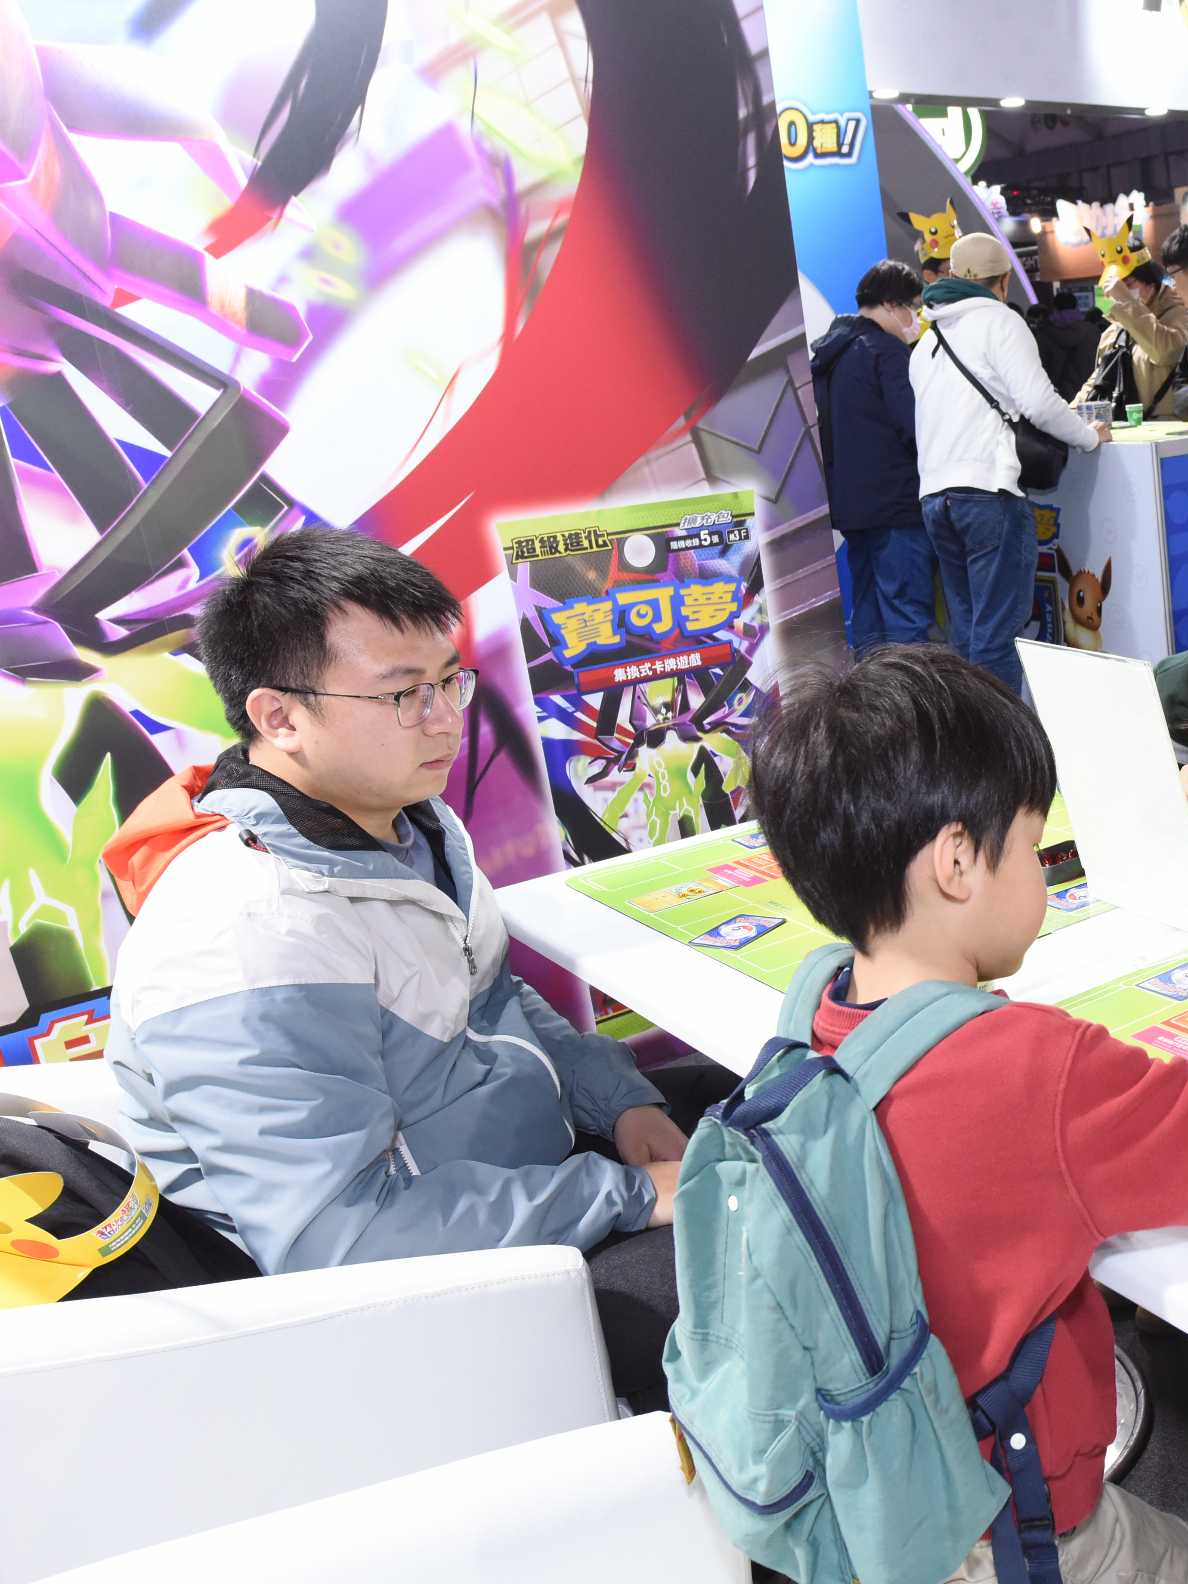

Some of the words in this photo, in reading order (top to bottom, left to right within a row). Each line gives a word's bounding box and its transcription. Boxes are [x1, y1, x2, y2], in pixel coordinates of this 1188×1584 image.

[513, 529, 611, 562] 超級進化
[550, 581, 739, 658] 寶可夢
[613, 652, 702, 682] 集換式卡牌遊戲
